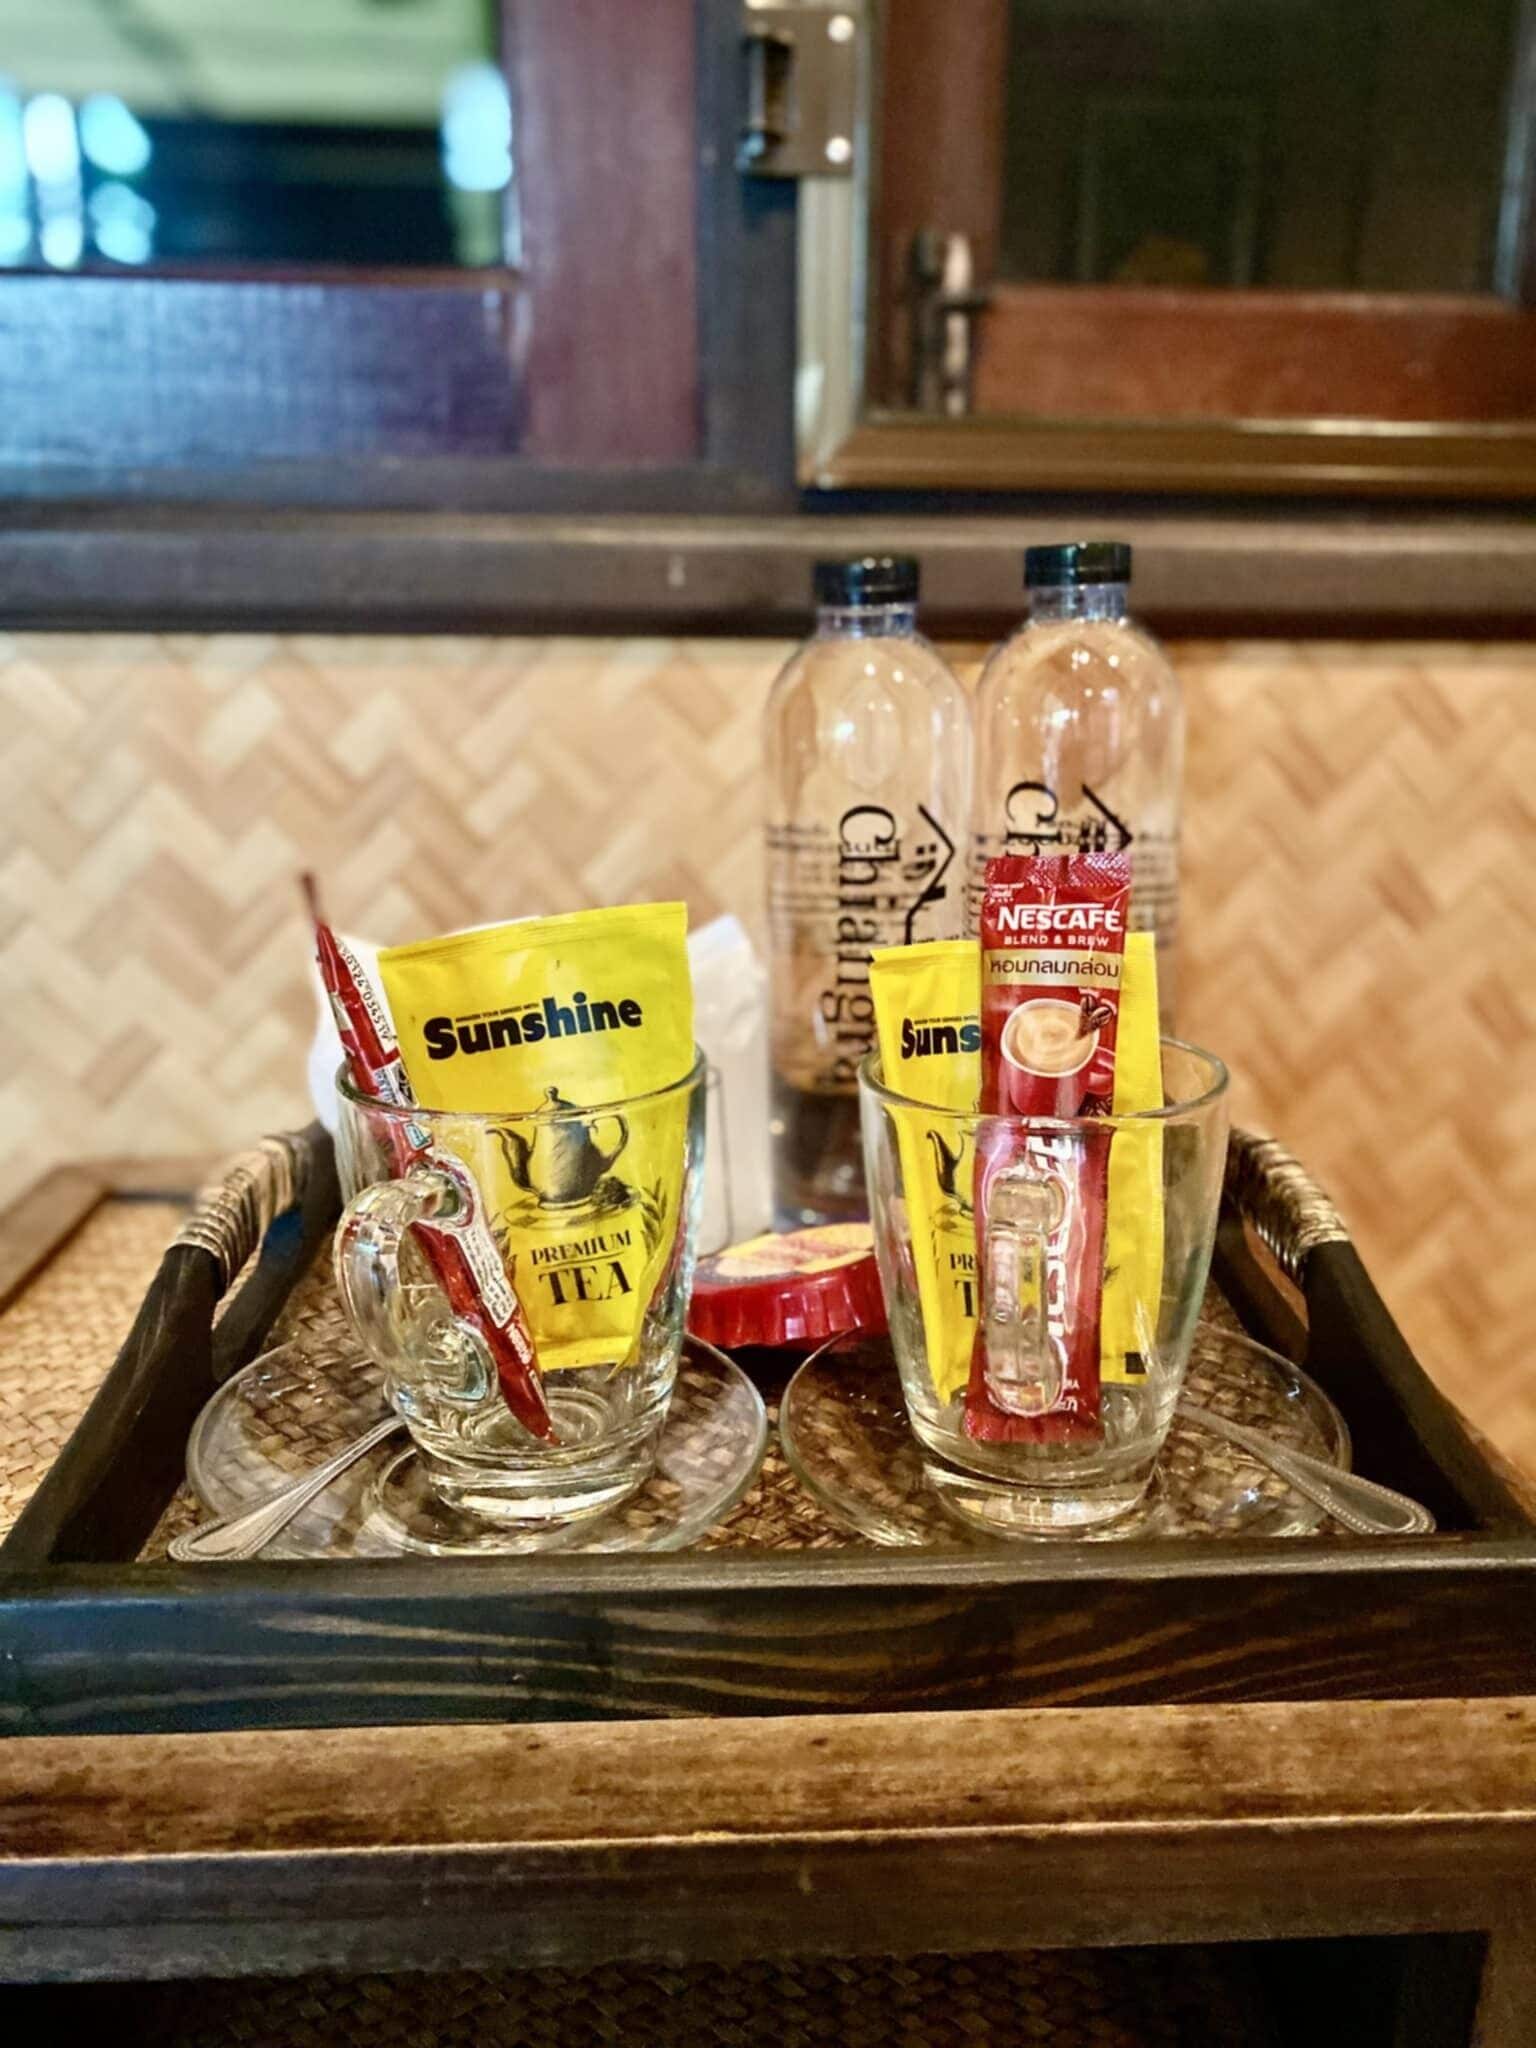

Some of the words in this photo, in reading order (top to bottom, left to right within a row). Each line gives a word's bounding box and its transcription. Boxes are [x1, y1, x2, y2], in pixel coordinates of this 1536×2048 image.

[1005, 781, 1062, 857] Ch
[817, 804, 900, 1087] Chiangra
[1003, 935, 1048, 945] BLEND
[1053, 935, 1063, 945] &
[1067, 935, 1109, 947] BREW
[989, 957, 1119, 979] หอมกลมกล่อม
[423, 991, 643, 1060] Sunshine
[901, 1017, 981, 1059] Suns
[530, 1229, 632, 1265] PREMIUM
[950, 1253, 974, 1270] PR
[538, 1261, 633, 1306] TEA
[954, 1279, 975, 1318] T
